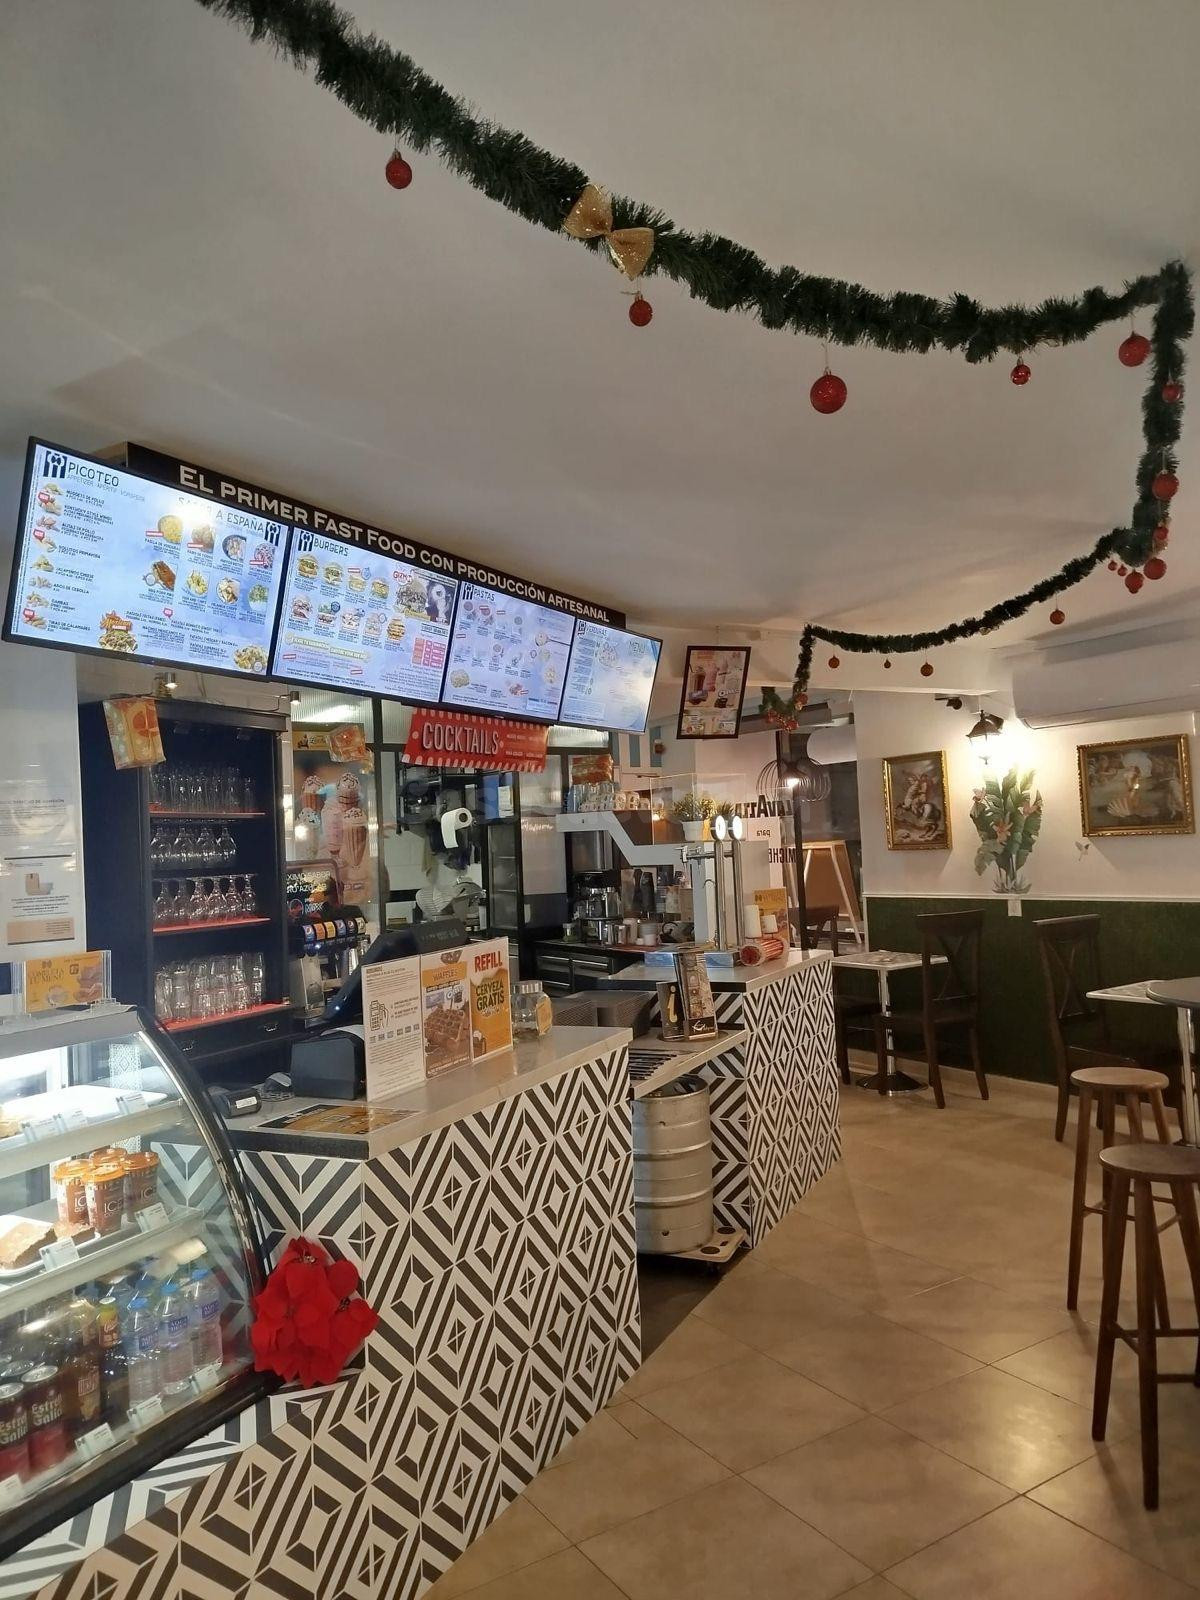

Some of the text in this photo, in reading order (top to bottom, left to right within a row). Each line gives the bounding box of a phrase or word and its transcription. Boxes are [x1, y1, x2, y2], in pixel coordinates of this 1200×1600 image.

[68, 461, 119, 487] PICOTEO
[227, 513, 264, 533] ESPAÑA
[179, 465, 214, 495] EL
[221, 481, 309, 525] PRIMER
[314, 511, 363, 541] FAST
[367, 531, 416, 559] FOOD
[420, 550, 454, 573] CON
[457, 561, 546, 603] PRODUCCIÓN
[547, 593, 610, 623] ARTESANAL
[313, 538, 349, 557] BURGERS
[71, 586, 89, 595] CEBOLLA
[473, 588, 495, 602] PASTAS
[422, 722, 499, 755] COCKTAILS
[474, 951, 503, 973] REFILL
[432, 969, 458, 982] WAFFLES
[476, 981, 504, 997] CERVEZA
[476, 993, 505, 1012] GRATIS
